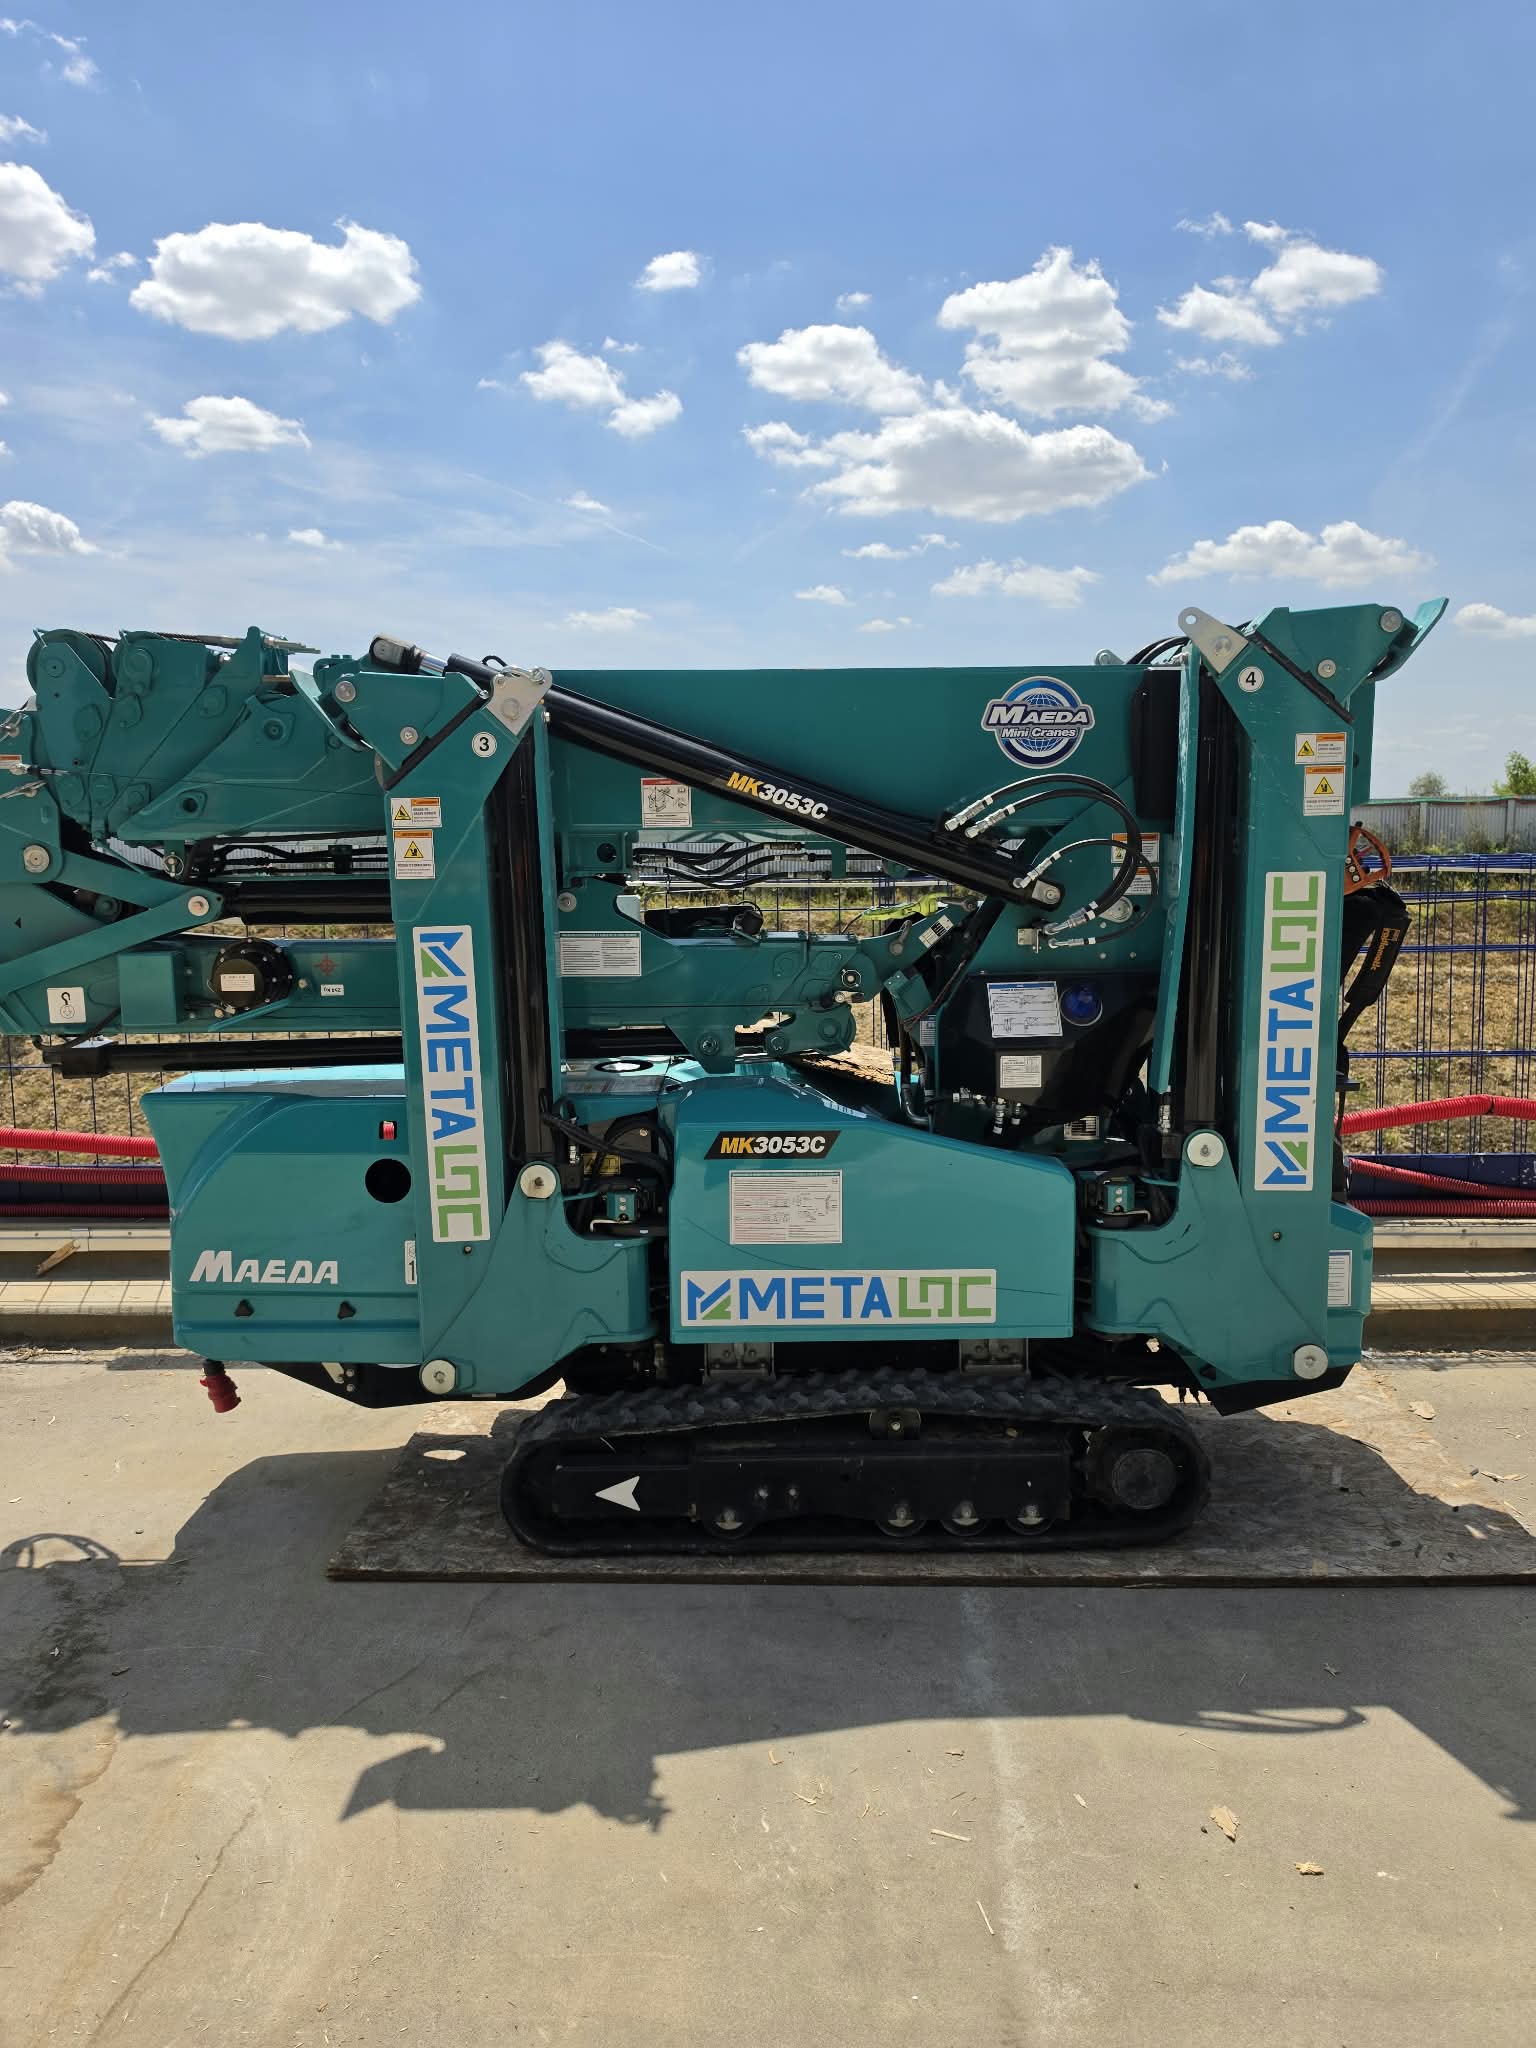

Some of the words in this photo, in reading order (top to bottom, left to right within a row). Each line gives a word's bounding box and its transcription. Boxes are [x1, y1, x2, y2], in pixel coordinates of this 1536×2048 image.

[1245, 671, 1257, 686] 4
[987, 705, 1089, 724] MAEDA
[1001, 728, 1030, 738] Mini
[1031, 727, 1077, 738] Cranes
[479, 736, 490, 752] 3
[726, 771, 829, 819] MK3053C
[720, 1136, 826, 1154] MK3053C
[188, 1249, 339, 1285] MAEDA
